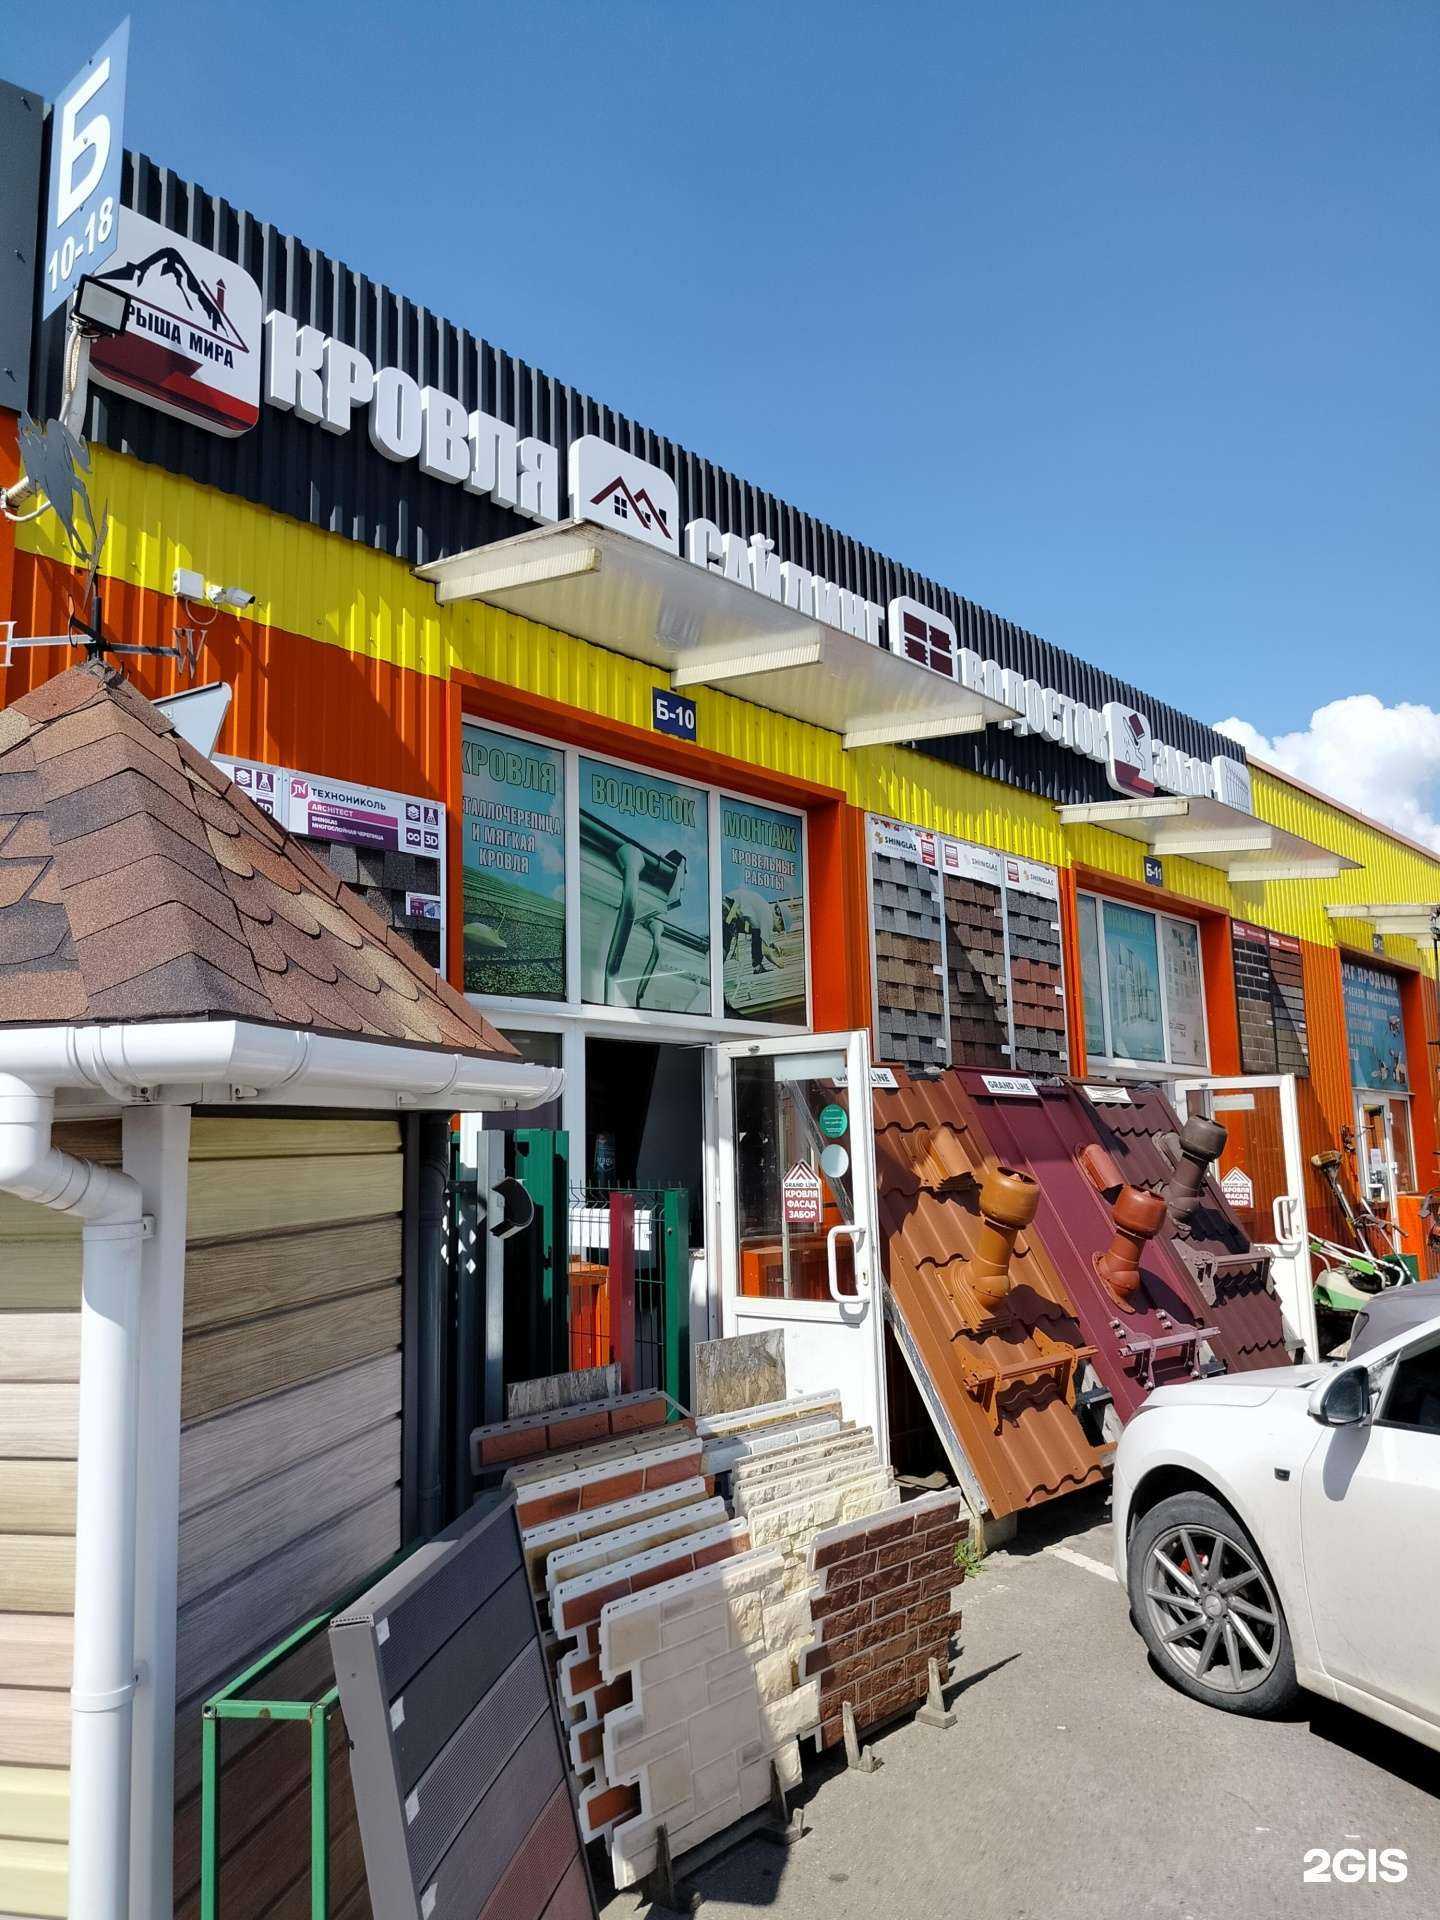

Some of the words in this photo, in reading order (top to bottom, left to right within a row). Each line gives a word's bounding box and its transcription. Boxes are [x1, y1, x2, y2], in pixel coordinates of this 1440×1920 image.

[57, 57, 111, 228] Б
[48, 196, 113, 292] 10-18
[127, 303, 181, 344] РЫША
[189, 332, 233, 369] МИРА
[265, 309, 558, 523] КРОВЛЯ
[656, 699, 694, 729] Б-10
[311, 787, 386, 811] ТЕХНОНИКОЛЬ
[312, 803, 354, 817] ARCHITECT
[591, 773, 696, 828] ВОДОСТОК
[462, 796, 560, 836] ТАЛЛОЧЕРЕПИЦА
[425, 834, 438, 846] 3D
[472, 822, 480, 841] И
[484, 825, 536, 853] МЯГКАЯ
[723, 810, 796, 853] МОНТАЖ
[884, 836, 917, 851] SHINGLAS
[479, 847, 529, 873] КРОВЛЯ
[731, 847, 796, 876] КРОВЕЛЬНЫЕ
[971, 858, 998, 872] SHINGLAS
[1146, 863, 1162, 880] Б-11
[744, 867, 784, 891] РАБОТЫ
[1030, 873, 1054, 887] SHINGLAS
[1357, 967, 1399, 993] ПРОДАЖА
[987, 1079, 1014, 1090] GRAND
[1016, 1080, 1031, 1092] LINE
[785, 1189, 818, 1198] КРОВЛЯ
[787, 1199, 817, 1209] ФАСАД
[788, 1210, 816, 1219] ЗАБОР
